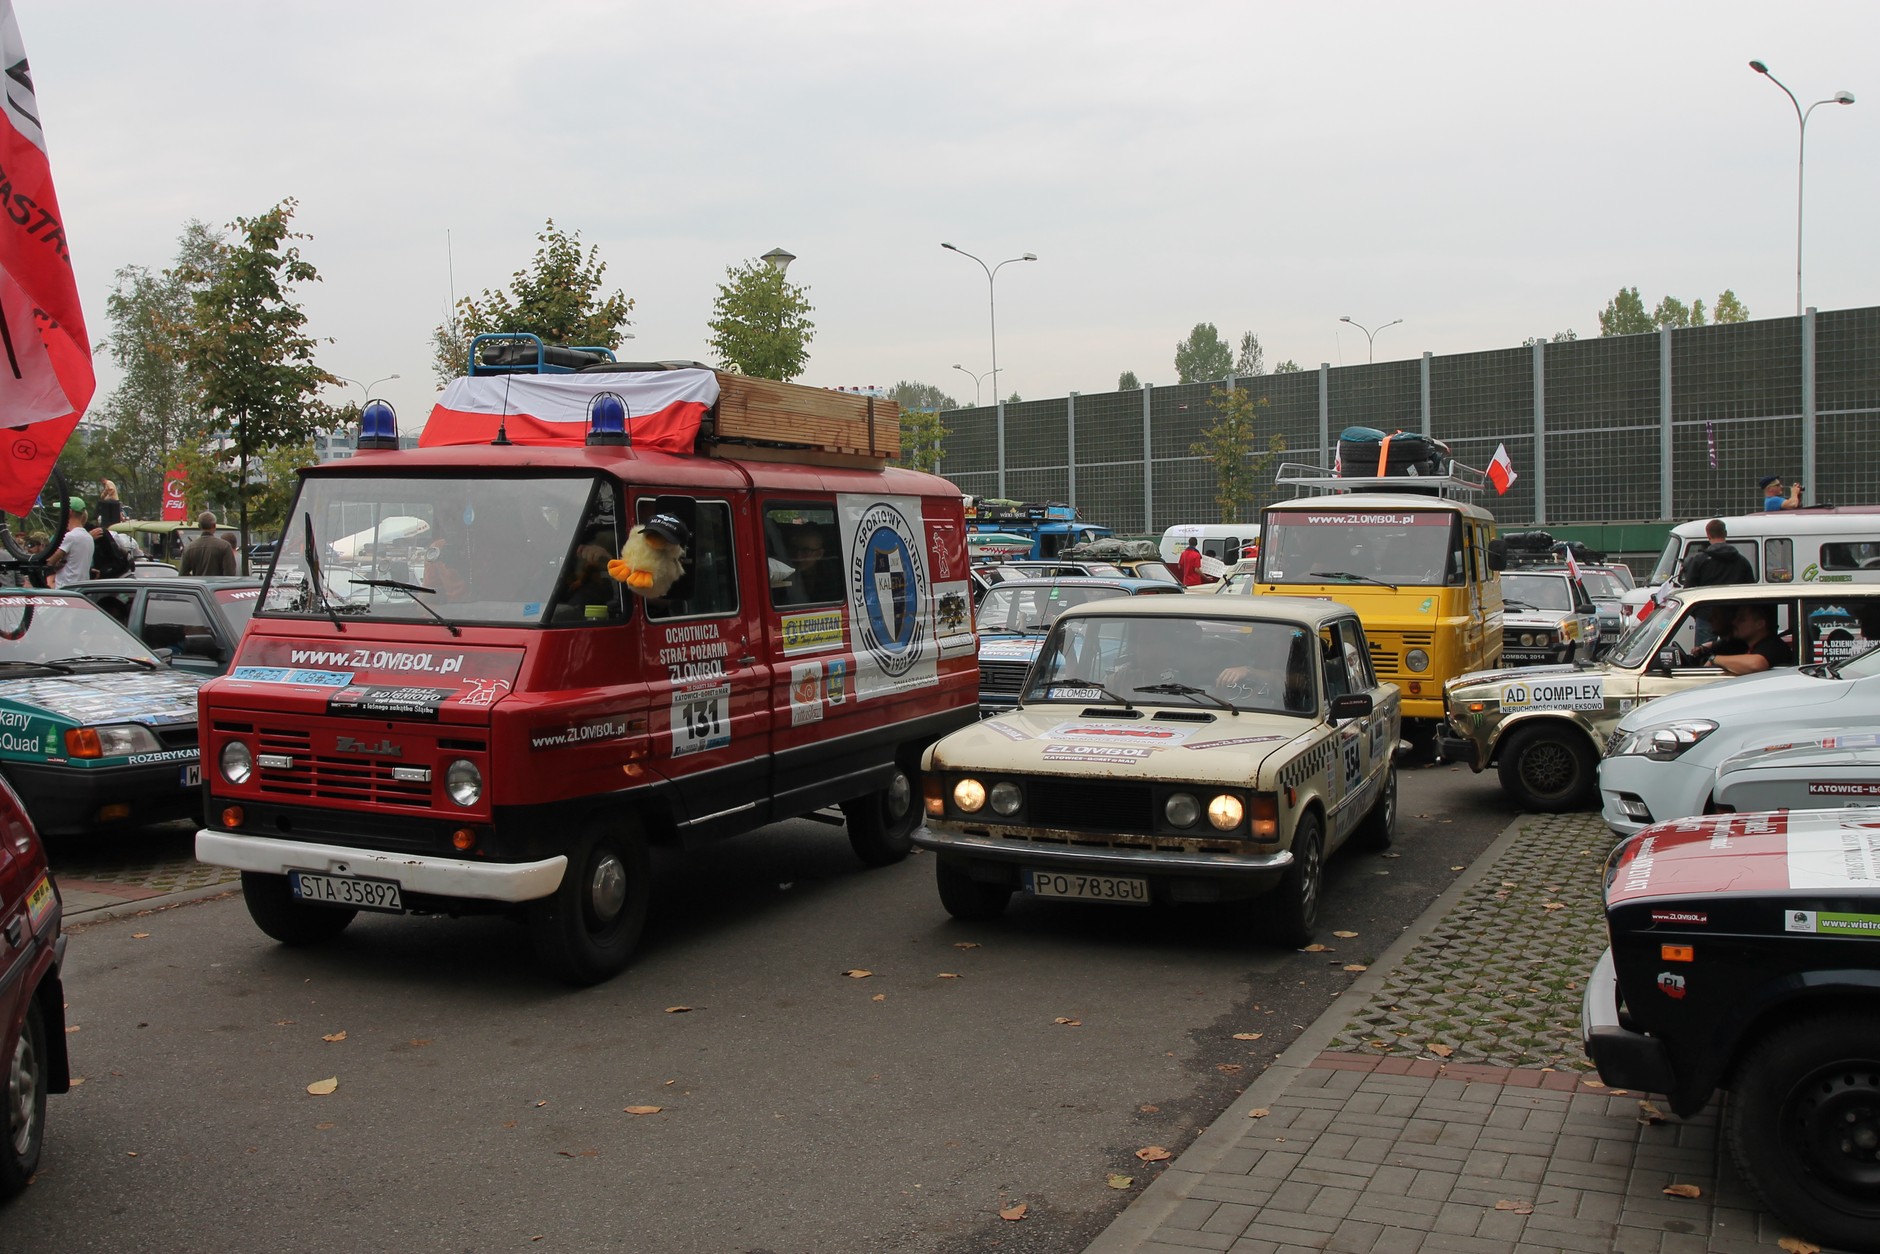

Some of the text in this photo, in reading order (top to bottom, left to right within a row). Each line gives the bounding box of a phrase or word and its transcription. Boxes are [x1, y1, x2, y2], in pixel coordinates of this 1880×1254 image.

[859, 510, 902, 548] SPORTOWY
[1308, 515, 1414, 524] www.ZLOMBOL.pl
[857, 557, 865, 608] KLUB
[0, 597, 69, 606] OMBOL.pl
[666, 624, 719, 643] OCHOTNICZA
[291, 650, 464, 674] www.ZLOMBOL.pl
[660, 642, 728, 665] STRAŻ POŻARNA
[668, 660, 727, 684] ZLOMBOL
[891, 656, 908, 671] 1921
[1506, 685, 1601, 702] AD COMPLEX
[1502, 702, 1602, 712] NIERUCHOMOŚCI KOMPLEKSOWO
[682, 699, 720, 740] 131
[532, 723, 625, 747] www.ZLOMBOL.pl
[1046, 745, 1149, 757] ZLOMBOL
[189, 766, 200, 784] W
[301, 876, 337, 900] STA
[340, 880, 400, 907] 35892
[1036, 874, 1069, 894] PO
[1075, 876, 1144, 899] 783GU
[1652, 913, 1707, 921] www.ZLOMBOL.pl
[1664, 977, 1681, 991] PL
